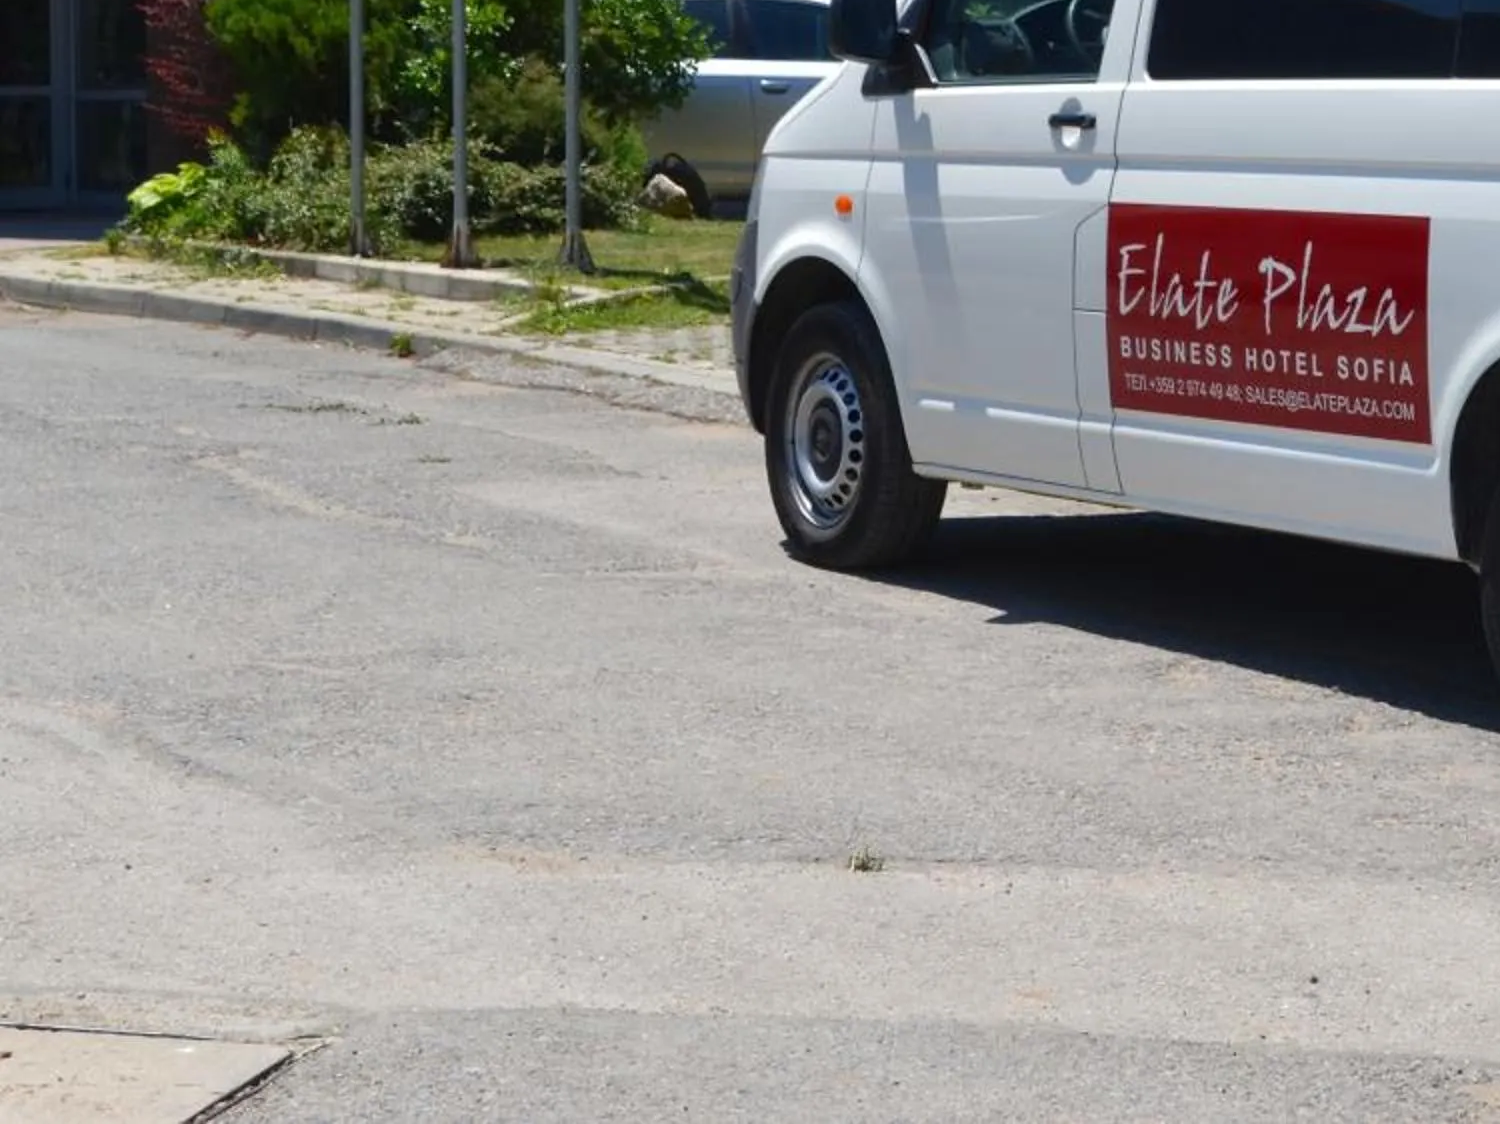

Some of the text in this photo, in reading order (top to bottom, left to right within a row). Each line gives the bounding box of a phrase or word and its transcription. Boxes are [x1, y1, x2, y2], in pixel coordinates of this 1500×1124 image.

[1118, 232, 1415, 337] Elate Plaza
[1120, 335, 1415, 386] BUSINESS HOTEL SOFIA
[1177, 379, 1185, 396] 2
[1209, 382, 1223, 400] 49
[1245, 385, 1415, 421] SALES@ELATEPLAZA.COM
